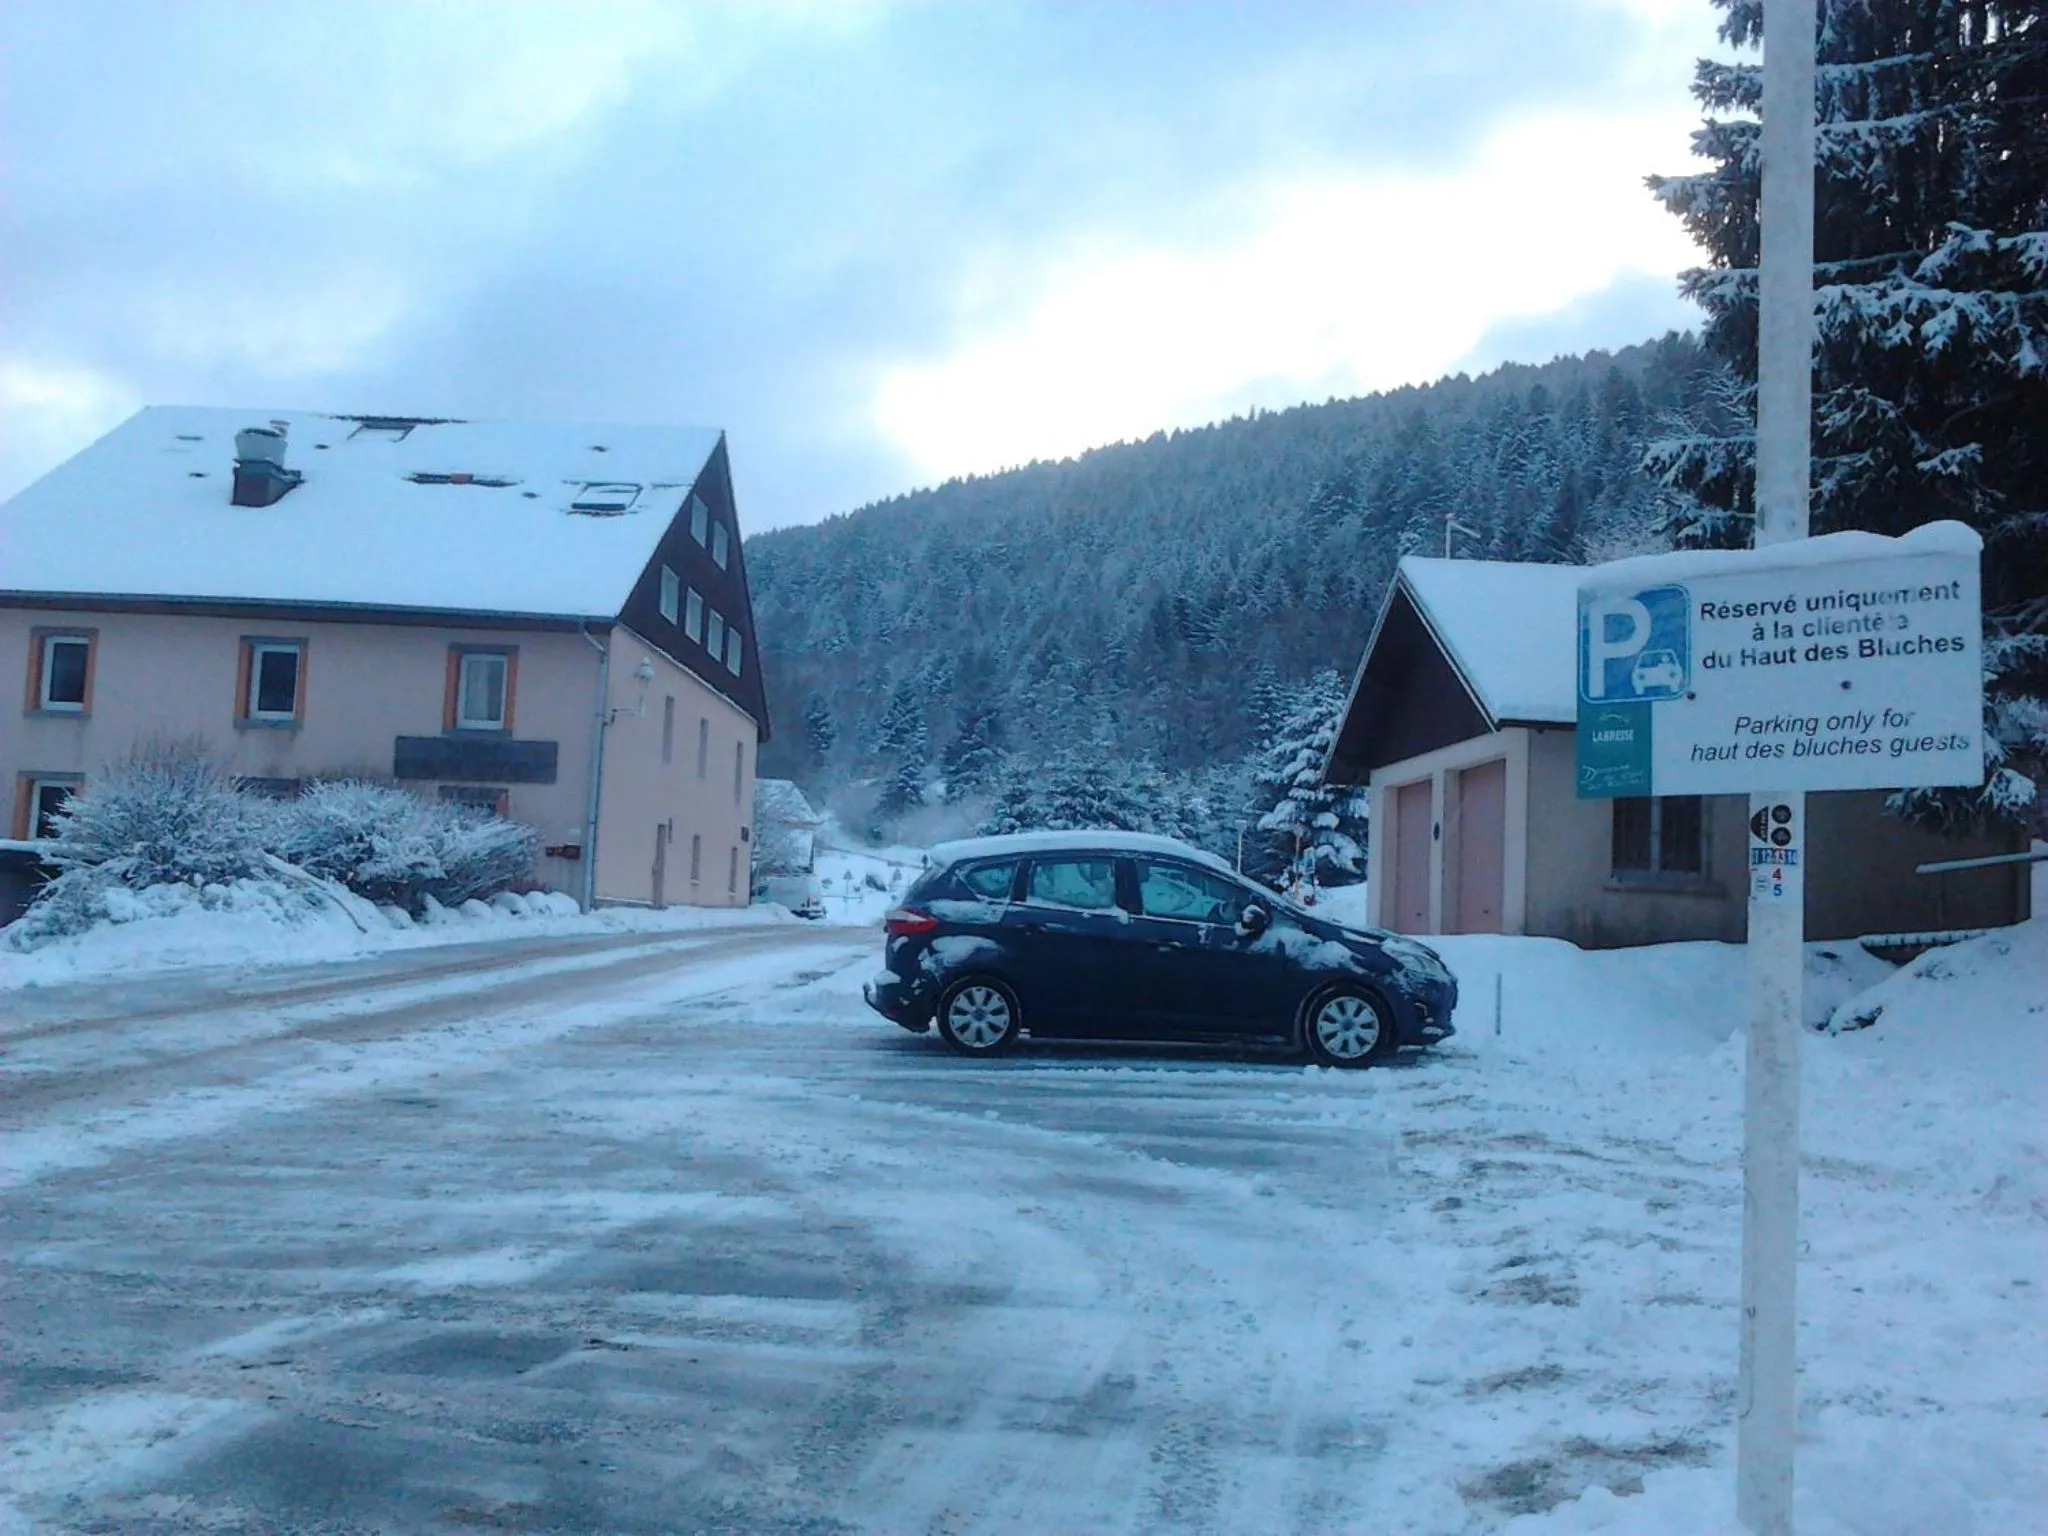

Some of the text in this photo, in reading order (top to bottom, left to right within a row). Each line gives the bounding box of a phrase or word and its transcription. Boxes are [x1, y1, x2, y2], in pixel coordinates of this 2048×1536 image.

[1700, 594, 1797, 620] Réservé
[1752, 612, 1909, 641] à la clientèe
[1702, 634, 1966, 669] du Haut des Bluches
[1734, 707, 1917, 737] Parking only for
[1690, 733, 1970, 762] haut des bluches guests
[1772, 868, 1782, 880] 4
[1773, 884, 1783, 896] 5
